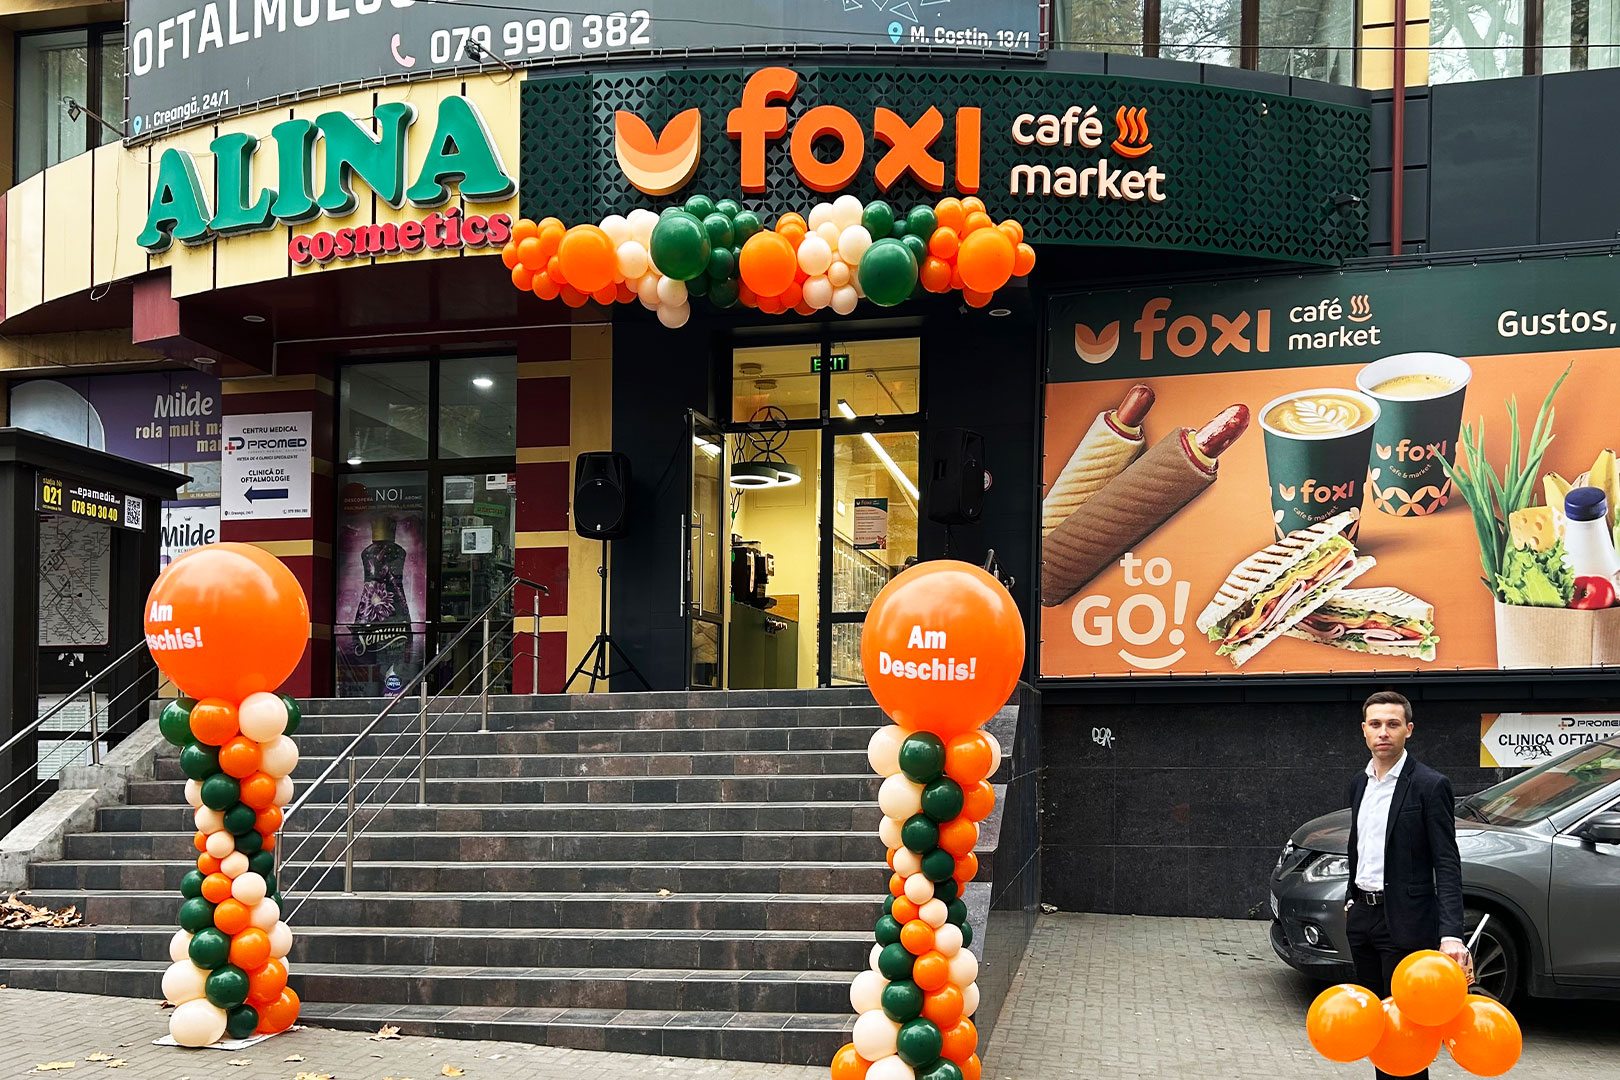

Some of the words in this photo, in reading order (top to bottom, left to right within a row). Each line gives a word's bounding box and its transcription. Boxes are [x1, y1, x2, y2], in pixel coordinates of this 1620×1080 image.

[430, 25, 492, 64] 079
[503, 17, 570, 57] 990
[582, 9, 651, 48] 382
[910, 26, 930, 43] M.
[934, 27, 993, 48] Costin,
[997, 30, 1030, 48] 13/1
[153, 99, 200, 127] Creangă,
[202, 89, 230, 111] 24/1
[1011, 104, 1104, 149] café
[137, 94, 516, 252] ALINA
[1010, 158, 1167, 202] market
[288, 206, 513, 266] cosmetics
[1289, 296, 1343, 324] café
[1497, 308, 1618, 338] Gustos,
[1288, 325, 1382, 351] market
[813, 357, 847, 372] EIT
[154, 390, 214, 418] Milde
[135, 421, 163, 439] rola
[169, 420, 201, 438] mult
[206, 423, 222, 436] m
[242, 427, 268, 435] CENTRU
[247, 438, 308, 450] PROMED
[240, 475, 290, 483] OFTALMOLOGIE
[248, 468, 274, 476] CLINICĂ
[43, 485, 62, 506] 021
[375, 488, 403, 502] NOI
[71, 499, 86, 515] 078
[86, 502, 97, 518] 50
[97, 505, 108, 520] 30
[108, 507, 118, 522] 40
[1314, 505, 1339, 521] market
[160, 523, 216, 548] Milde
[1119, 552, 1173, 587] to
[149, 600, 173, 623] Am
[1071, 579, 1191, 647] GO!
[907, 625, 947, 649] Am
[879, 651, 977, 681] Deschis!
[1577, 719, 1620, 728] PROME
[1498, 733, 1555, 746] CLINICA
